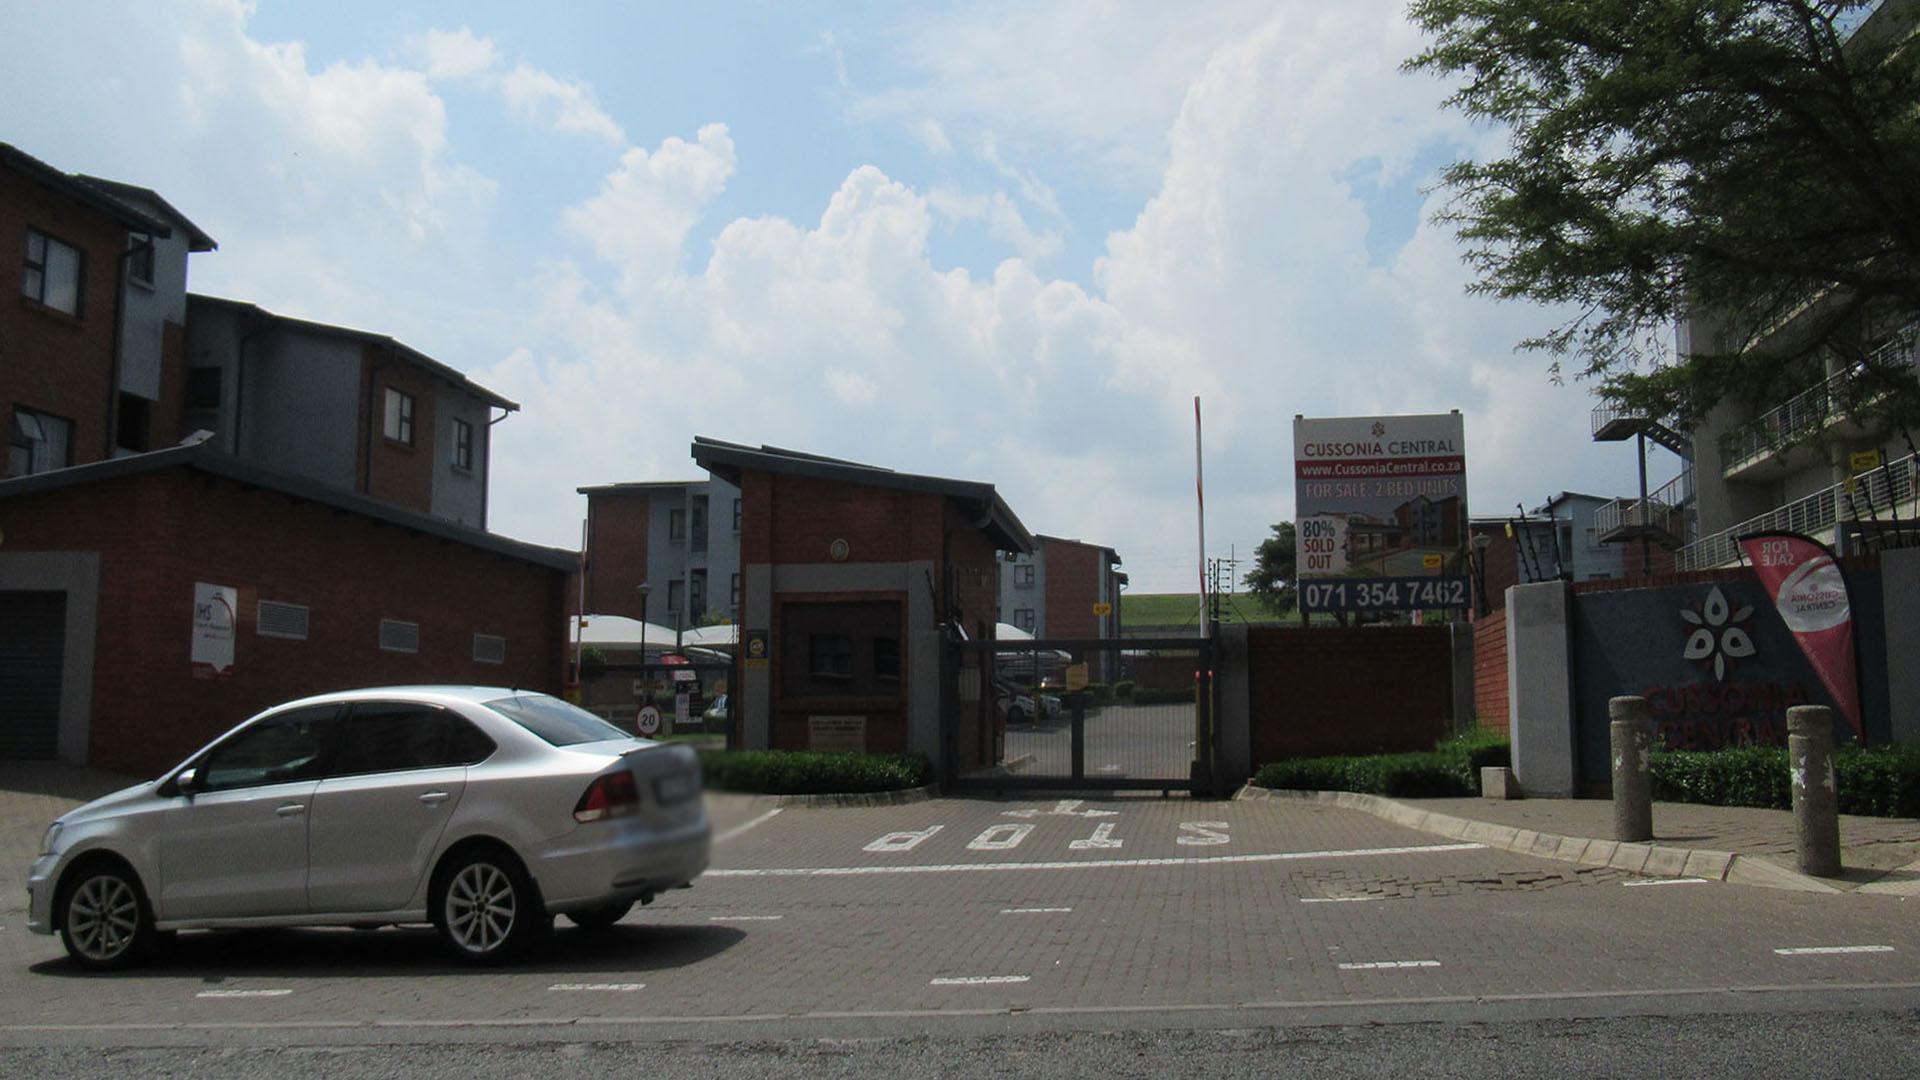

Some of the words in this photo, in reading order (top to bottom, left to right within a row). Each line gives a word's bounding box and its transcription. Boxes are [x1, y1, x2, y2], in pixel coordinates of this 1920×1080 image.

[1304, 442, 1383, 457] CUSSONIA
[1387, 440, 1456, 455] CENTRAL
[1302, 461, 1461, 476] www.CussoniaCentral.co.za
[1306, 483, 1331, 498] FOR
[1375, 481, 1385, 496] 2
[1387, 481, 1413, 496] BED
[1417, 479, 1458, 495] UNITS
[1303, 520, 1335, 538] 80%
[1304, 538, 1335, 554] SOLD
[1307, 555, 1332, 570] OUT
[1306, 583, 1346, 607] 071
[1357, 582, 1399, 606] 354
[1406, 580, 1464, 605] 7462
[1645, 683, 1803, 716] CUSSONIA
[642, 713, 655, 726] 20
[862, 821, 1231, 851] STOP
